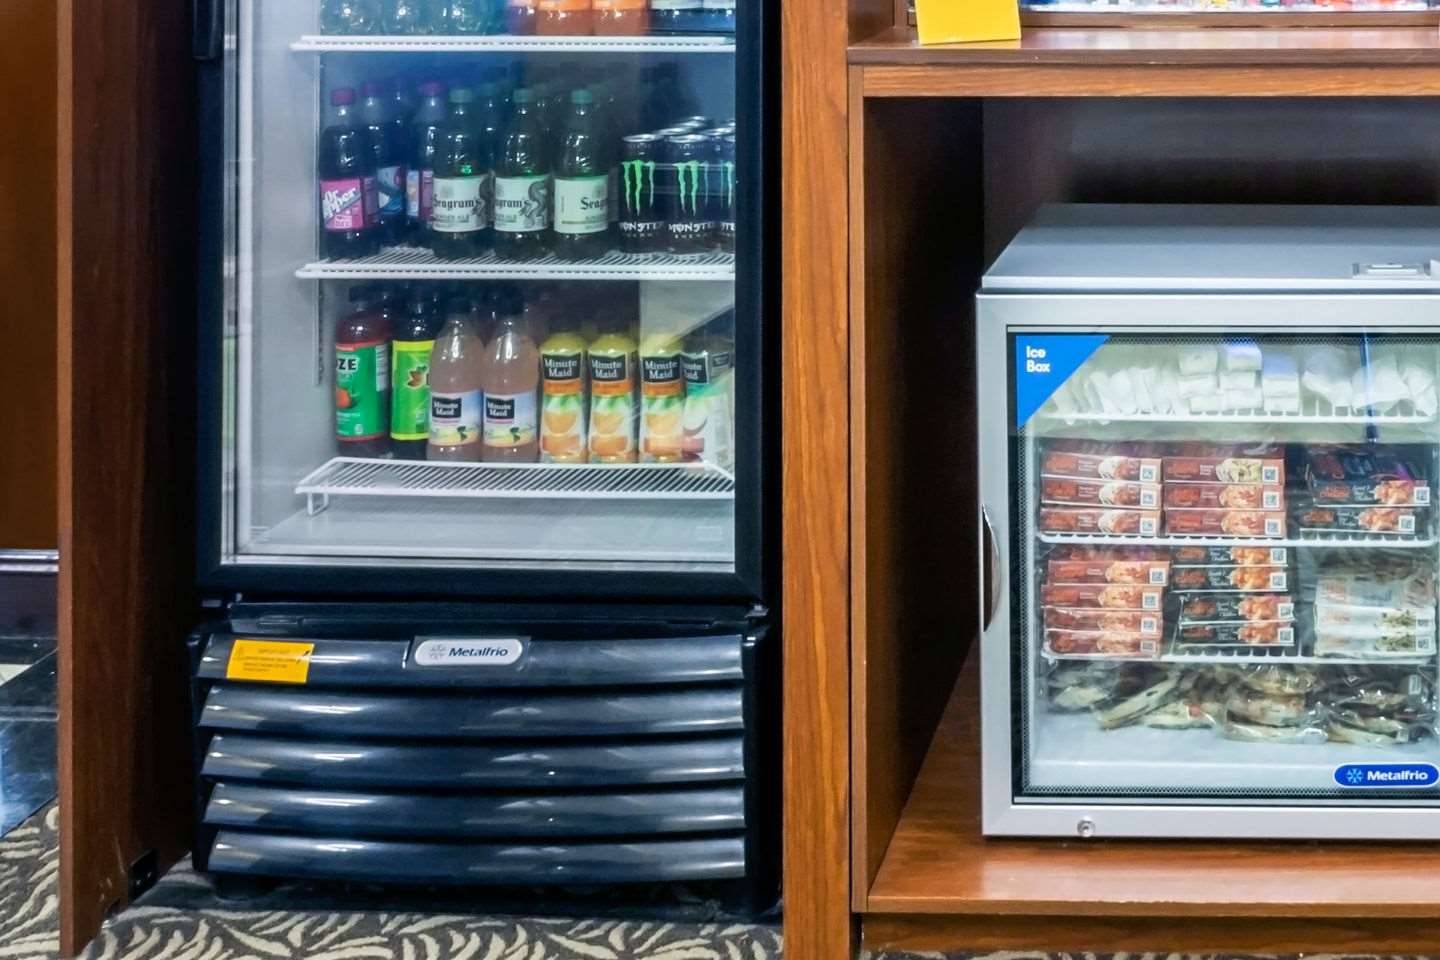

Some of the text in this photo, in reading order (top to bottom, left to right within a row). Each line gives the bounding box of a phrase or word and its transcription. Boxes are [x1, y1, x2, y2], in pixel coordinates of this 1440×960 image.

[1026, 345, 1046, 358] Ice
[544, 358, 578, 368] Minute
[644, 360, 678, 370] Minute
[1026, 360, 1051, 373] Box
[549, 368, 572, 377] Maid
[649, 369, 673, 379] Maid
[448, 647, 509, 657] Metalfrio
[1367, 770, 1429, 781] Metalfrio
